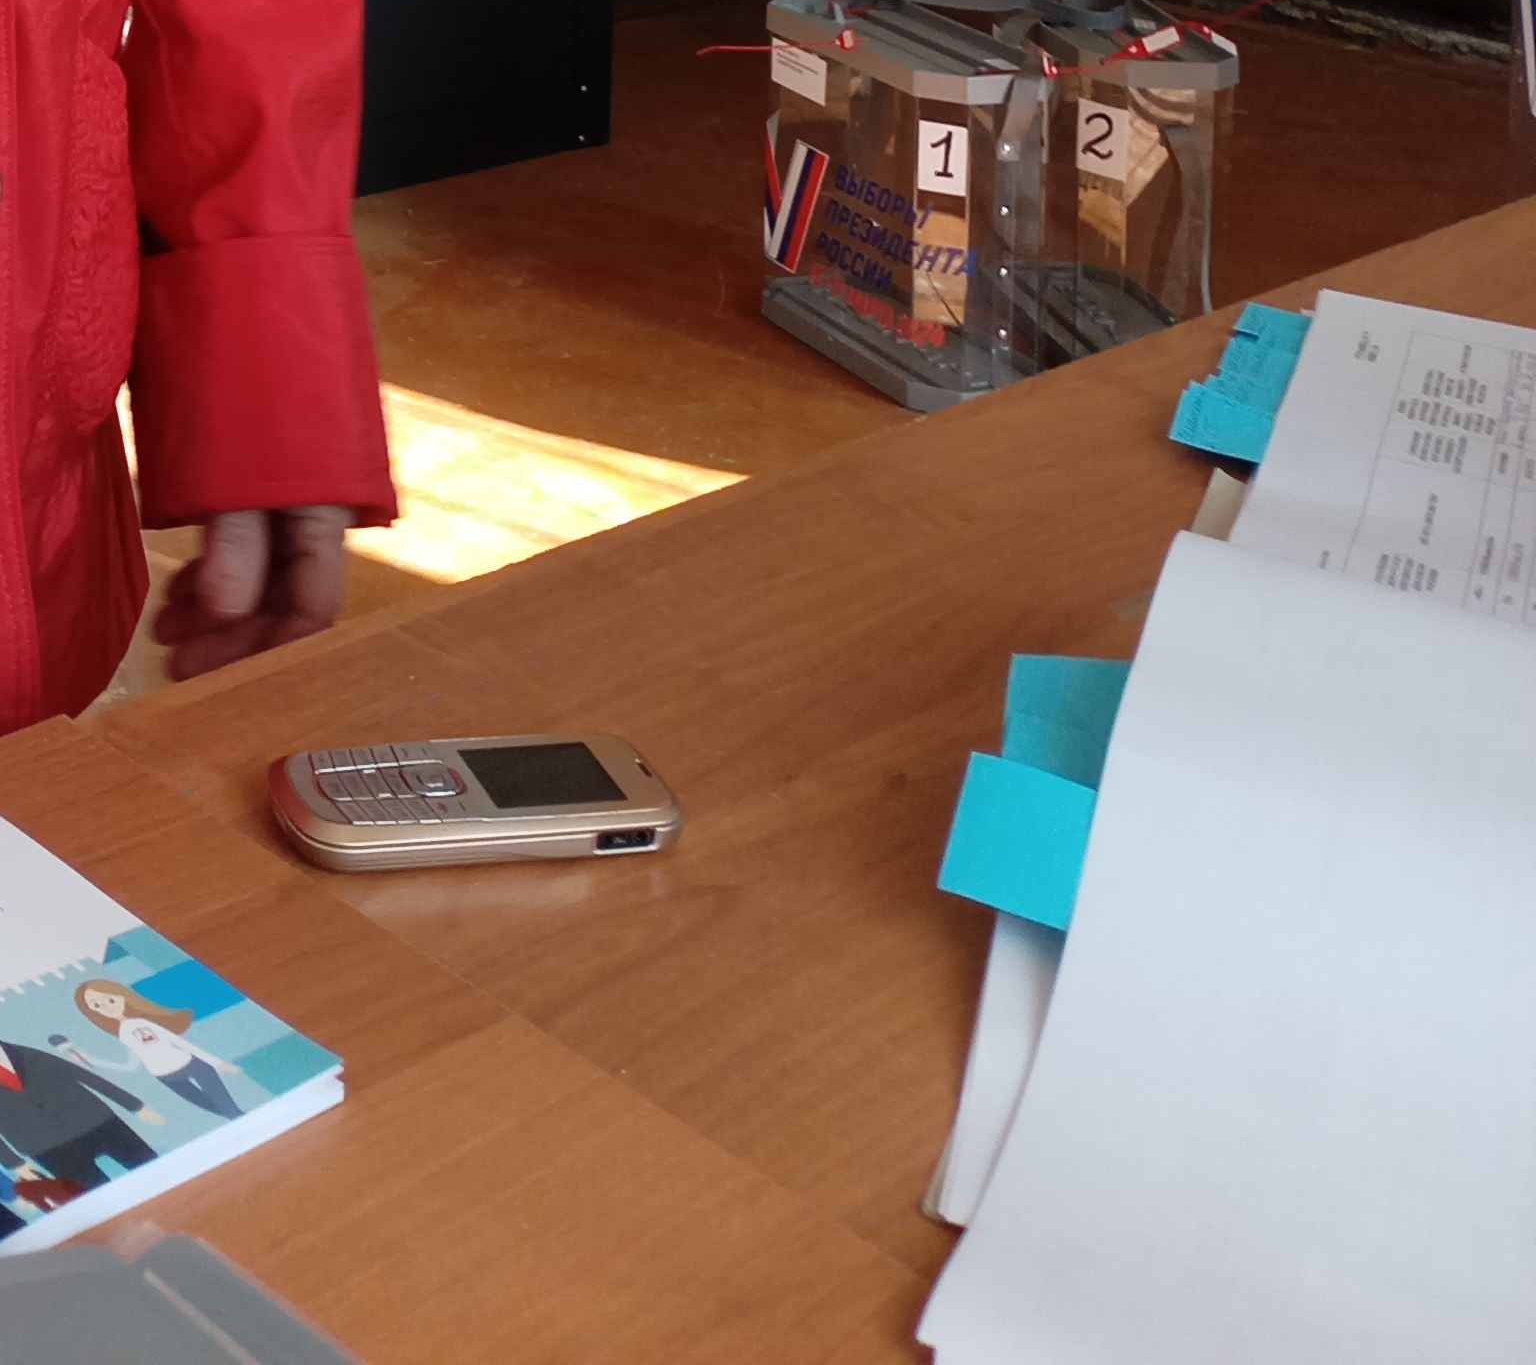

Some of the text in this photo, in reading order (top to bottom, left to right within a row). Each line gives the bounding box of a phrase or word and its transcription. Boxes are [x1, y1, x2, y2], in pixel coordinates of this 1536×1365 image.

[930, 130, 953, 178] 1
[1081, 112, 1113, 160] 2
[835, 165, 934, 229] ВЫБОРЫ
[816, 231, 894, 292] РОССИИ
[824, 198, 977, 278] ПРЕЗИДЕНТА
